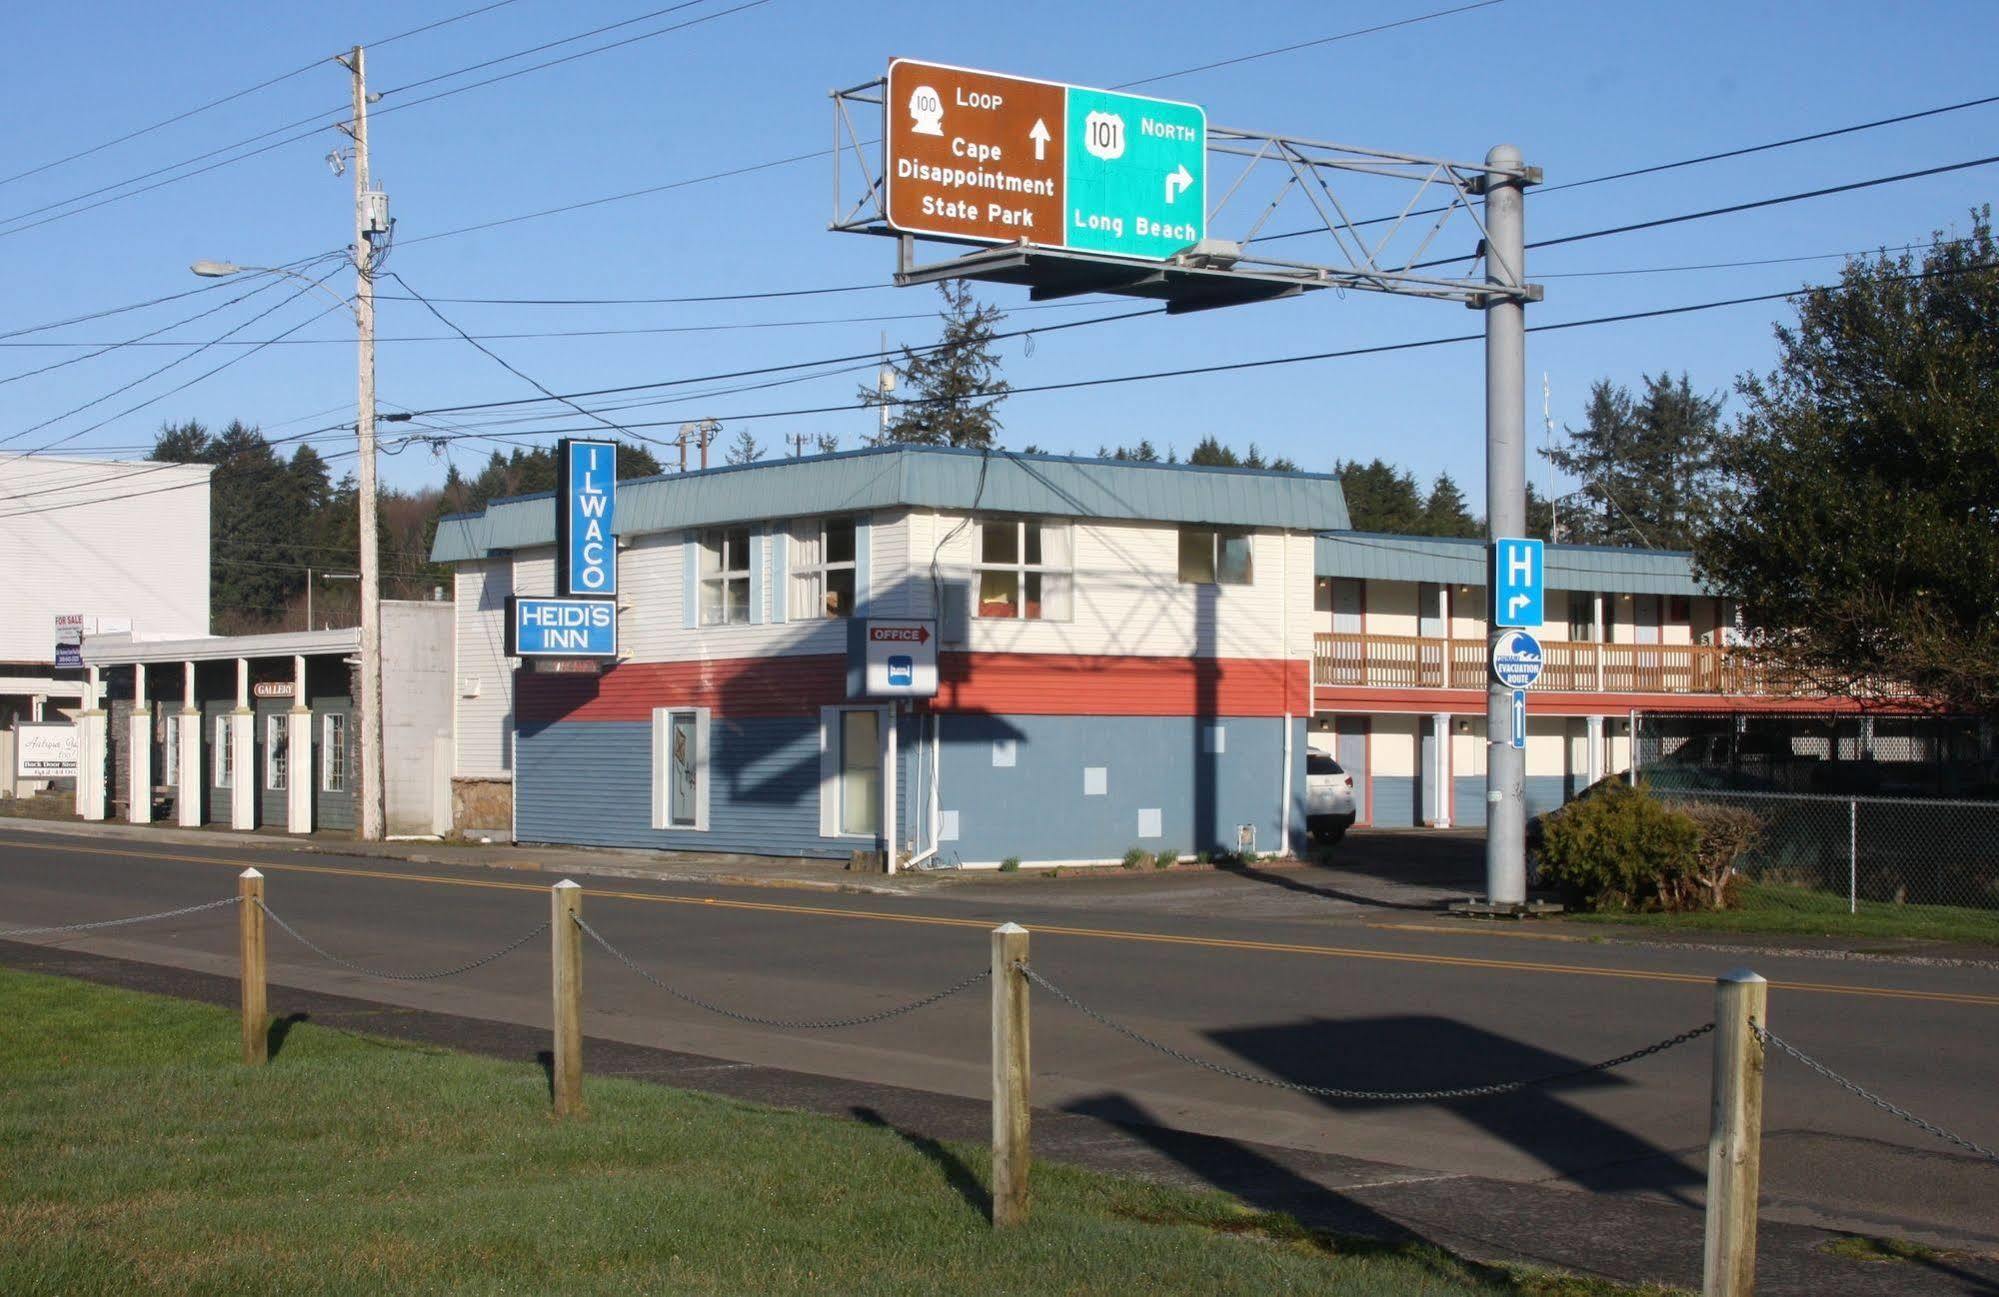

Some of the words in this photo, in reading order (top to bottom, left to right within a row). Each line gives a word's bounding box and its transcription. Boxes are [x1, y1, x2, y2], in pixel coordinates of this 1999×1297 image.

[917, 96, 936, 113] 100
[1091, 121, 1117, 149] 101
[952, 137, 1001, 162] Cape
[898, 158, 1054, 197] Disappointment
[922, 196, 978, 220] State
[988, 203, 1033, 227] Park
[1074, 209, 1123, 238] Long
[1136, 217, 1196, 241] Beach
[580, 448, 607, 588] ILWACO
[1508, 545, 1532, 587] H
[56, 616, 66, 626] FOR
[67, 615, 83, 625] SALE
[522, 605, 610, 627] HEIDI'S
[544, 629, 589, 649] INN
[875, 631, 920, 640] OFFICE
[1498, 663, 1539, 673] EVACUATION
[1507, 674, 1529, 683] ROUTE
[258, 685, 292, 695] GALLERY
